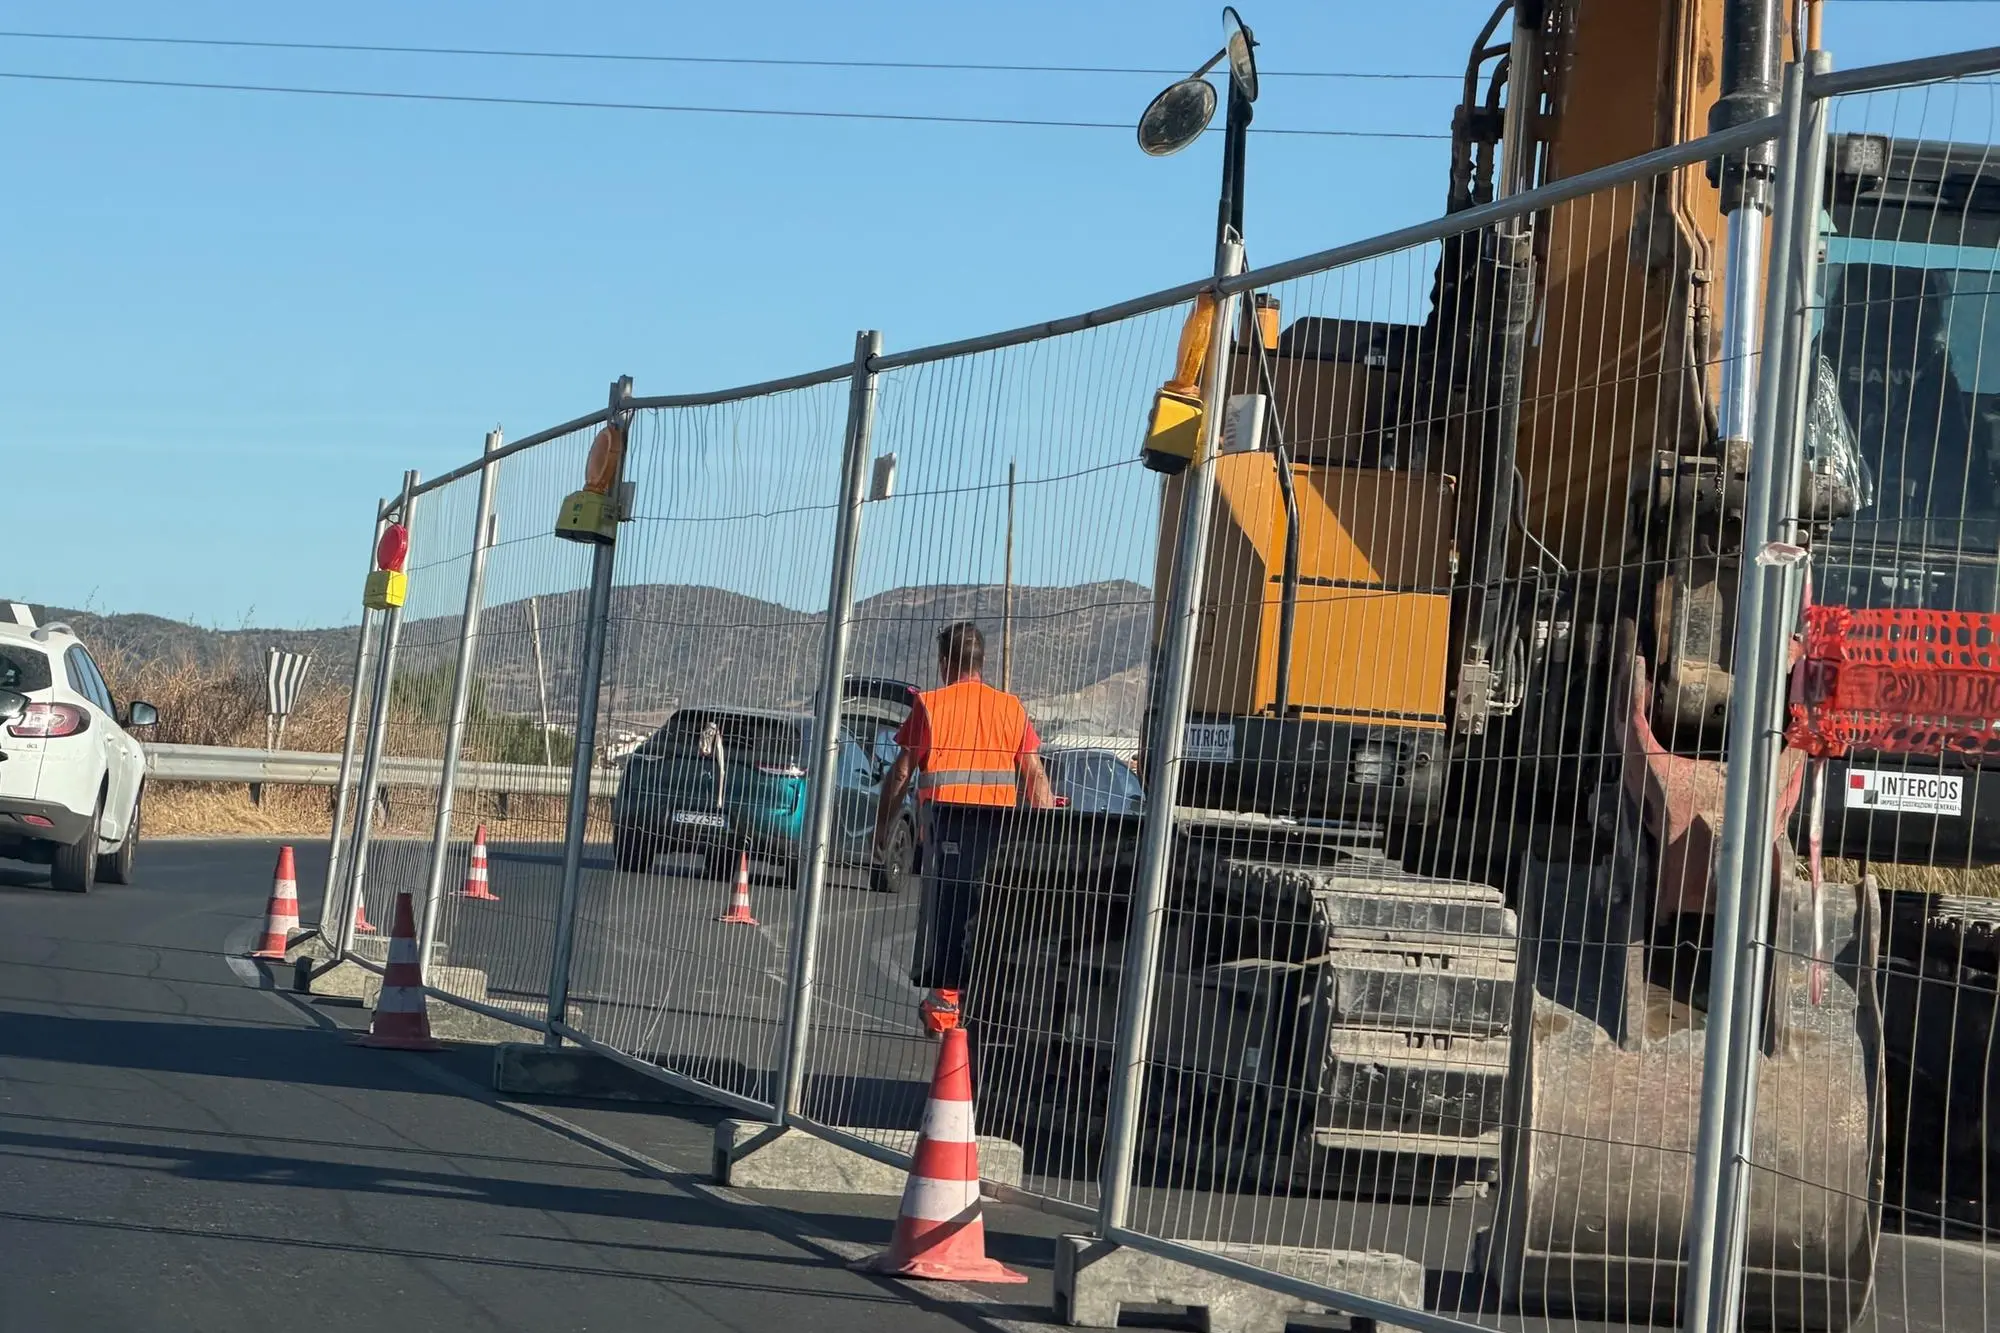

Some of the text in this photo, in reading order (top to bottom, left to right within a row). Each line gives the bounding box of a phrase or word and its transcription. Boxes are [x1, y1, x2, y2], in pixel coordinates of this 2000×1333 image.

[1848, 366, 1923, 385] SANY
[1183, 728, 1232, 747] NTERCOS
[1881, 776, 1958, 800] INTERCOS
